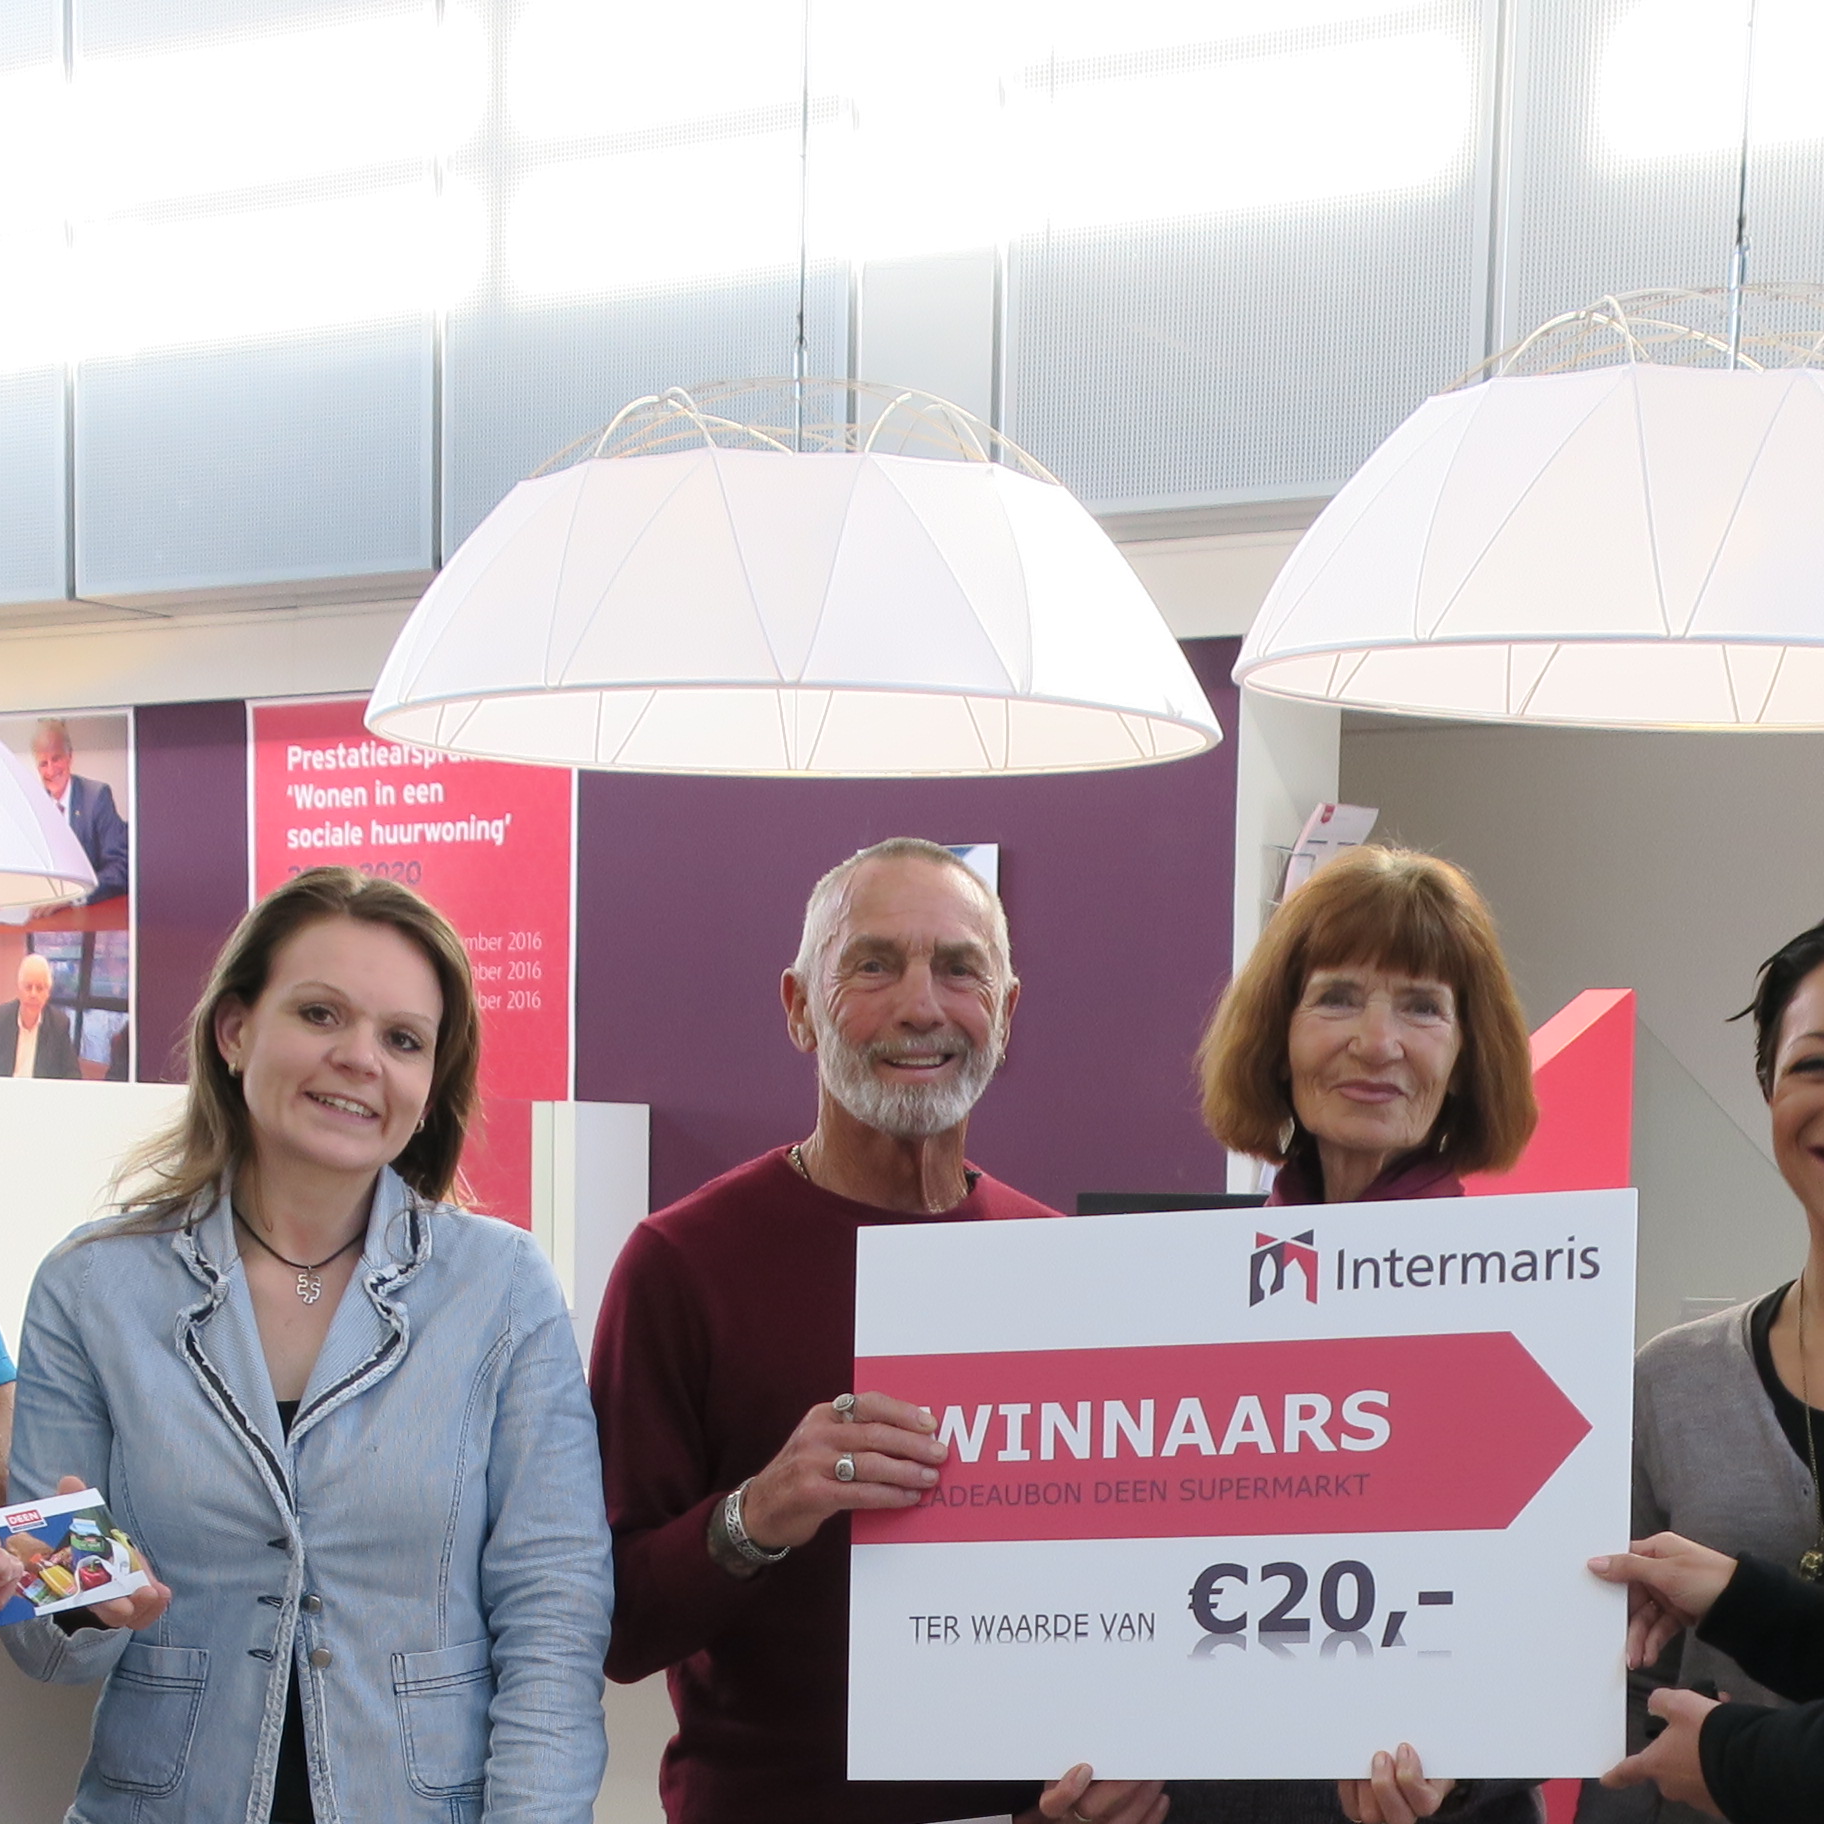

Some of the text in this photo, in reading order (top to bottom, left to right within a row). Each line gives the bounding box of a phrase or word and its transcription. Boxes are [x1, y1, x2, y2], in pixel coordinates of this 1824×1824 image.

[287, 779, 445, 810] ‘Wonen in een
[287, 812, 512, 848] sociale huurwoning’
[507, 931, 543, 951] 2016
[507, 961, 542, 980] 2016
[506, 990, 542, 1010] 2016
[1336, 1235, 1601, 1291] Intermaris
[922, 1389, 1392, 1463] WINNAARS
[1093, 1479, 1167, 1504] DEEN
[1179, 1473, 1371, 1501] SUPERMARKT
[7, 1511, 39, 1525] DEEN
[909, 1559, 1454, 1648] TER WAARDE VAN €20,-
